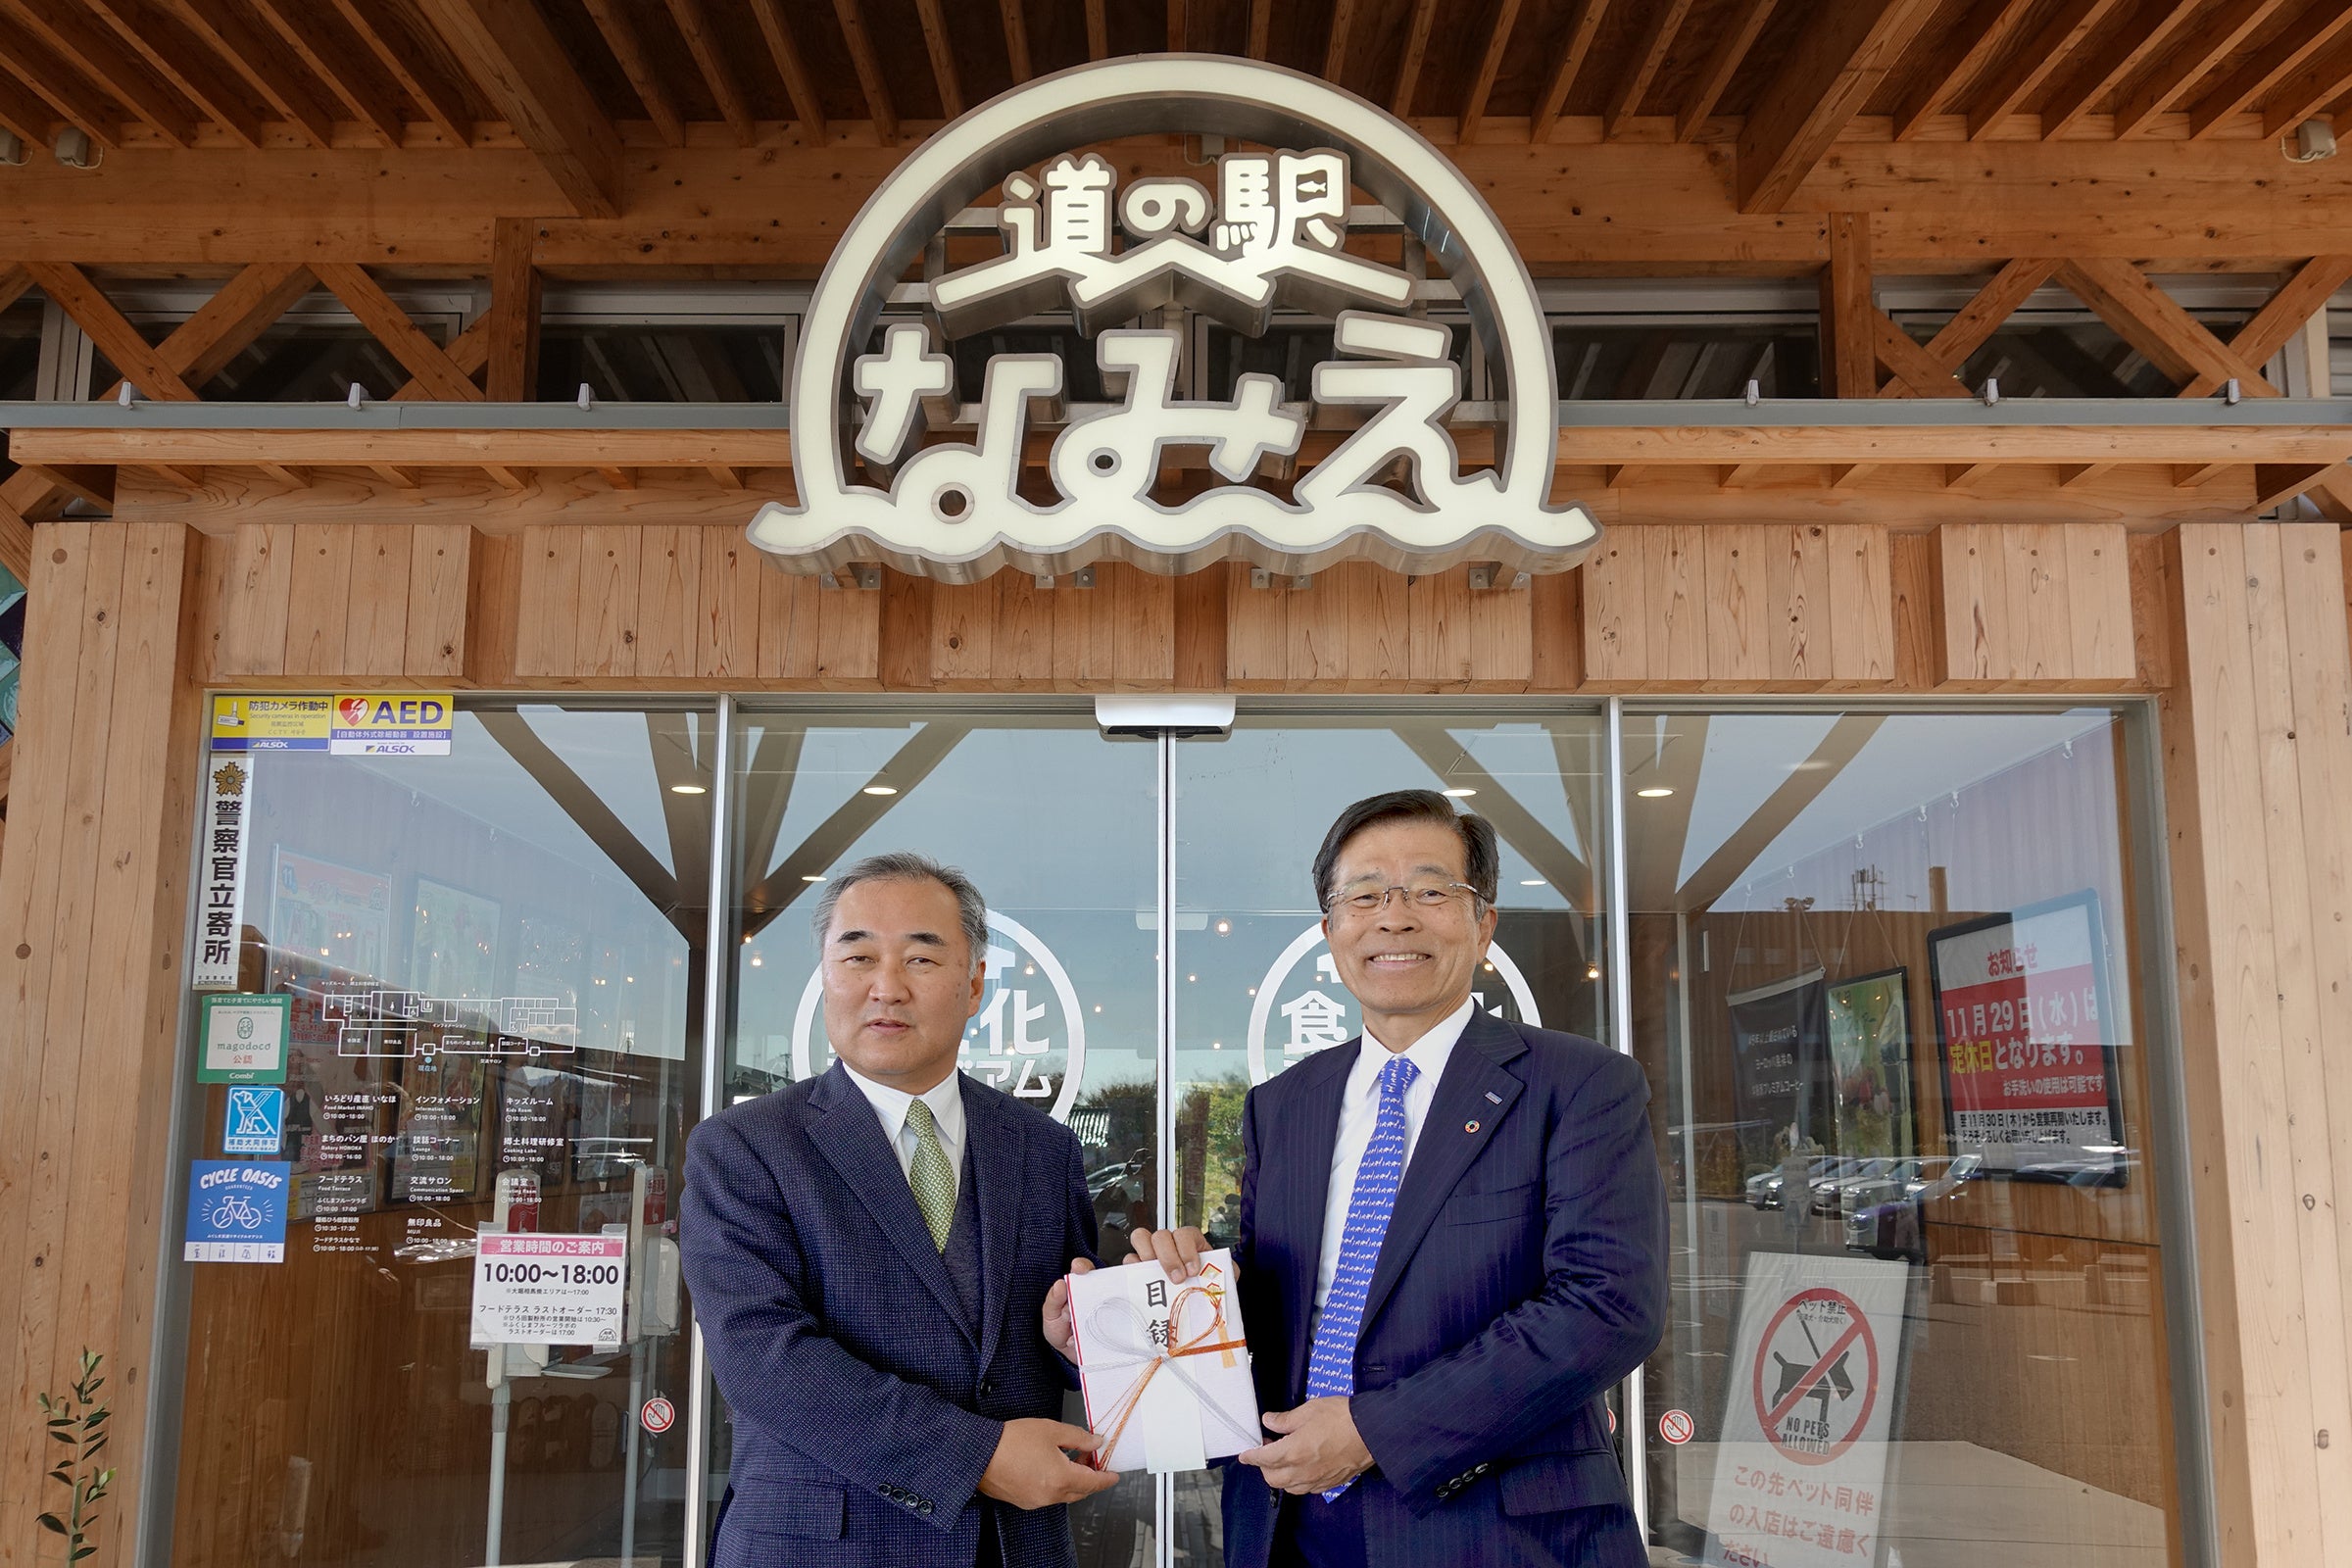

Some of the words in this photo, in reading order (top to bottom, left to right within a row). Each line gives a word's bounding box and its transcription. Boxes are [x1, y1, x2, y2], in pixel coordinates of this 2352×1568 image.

[985, 147, 1367, 294] 道の駅
[853, 310, 1509, 534] なみえ
[249, 701, 328, 711] 防犯カメラ作動中
[370, 701, 444, 724] AED
[375, 745, 416, 754] ALSOK
[203, 800, 242, 965] 警察官立寄所
[1986, 942, 2038, 977] お知らせ
[217, 1041, 271, 1053] magodoco
[1949, 1031, 2084, 1075] 定休日となります。
[233, 1054, 253, 1064] 公認
[324, 1094, 369, 1103] いろどり産直
[372, 1095, 396, 1103] いなほ
[416, 1096, 480, 1104] インフォメーション
[506, 1097, 554, 1105] キッズルーム
[321, 1134, 368, 1144] まちのパン屋
[370, 1135, 395, 1144] ほのか
[413, 1136, 461, 1145] 談話コーナー
[503, 1137, 564, 1147] 郷土料理研修室
[199, 1167, 240, 1190] CYCLE
[241, 1167, 283, 1190] OASIS
[318, 1175, 363, 1184] フードテラス
[410, 1176, 453, 1185] 交流サロン
[501, 1177, 529, 1187] 会議室
[407, 1218, 442, 1227] 無印良品
[500, 1239, 605, 1255] 営業時間のご案内
[479, 1304, 529, 1313] フードテラス
[533, 1305, 592, 1314] ラストオーダー
[1798, 1298, 1846, 1315] ペット禁止
[1146, 1279, 1178, 1349] 目録
[1786, 1416, 1800, 1433] NO
[1803, 1419, 1831, 1440] PETS
[1781, 1434, 1831, 1455] ALLOWED
[1734, 1465, 1875, 1517] この先ペット同伴
[1729, 1503, 1870, 1558] の入店はご遠慮く
